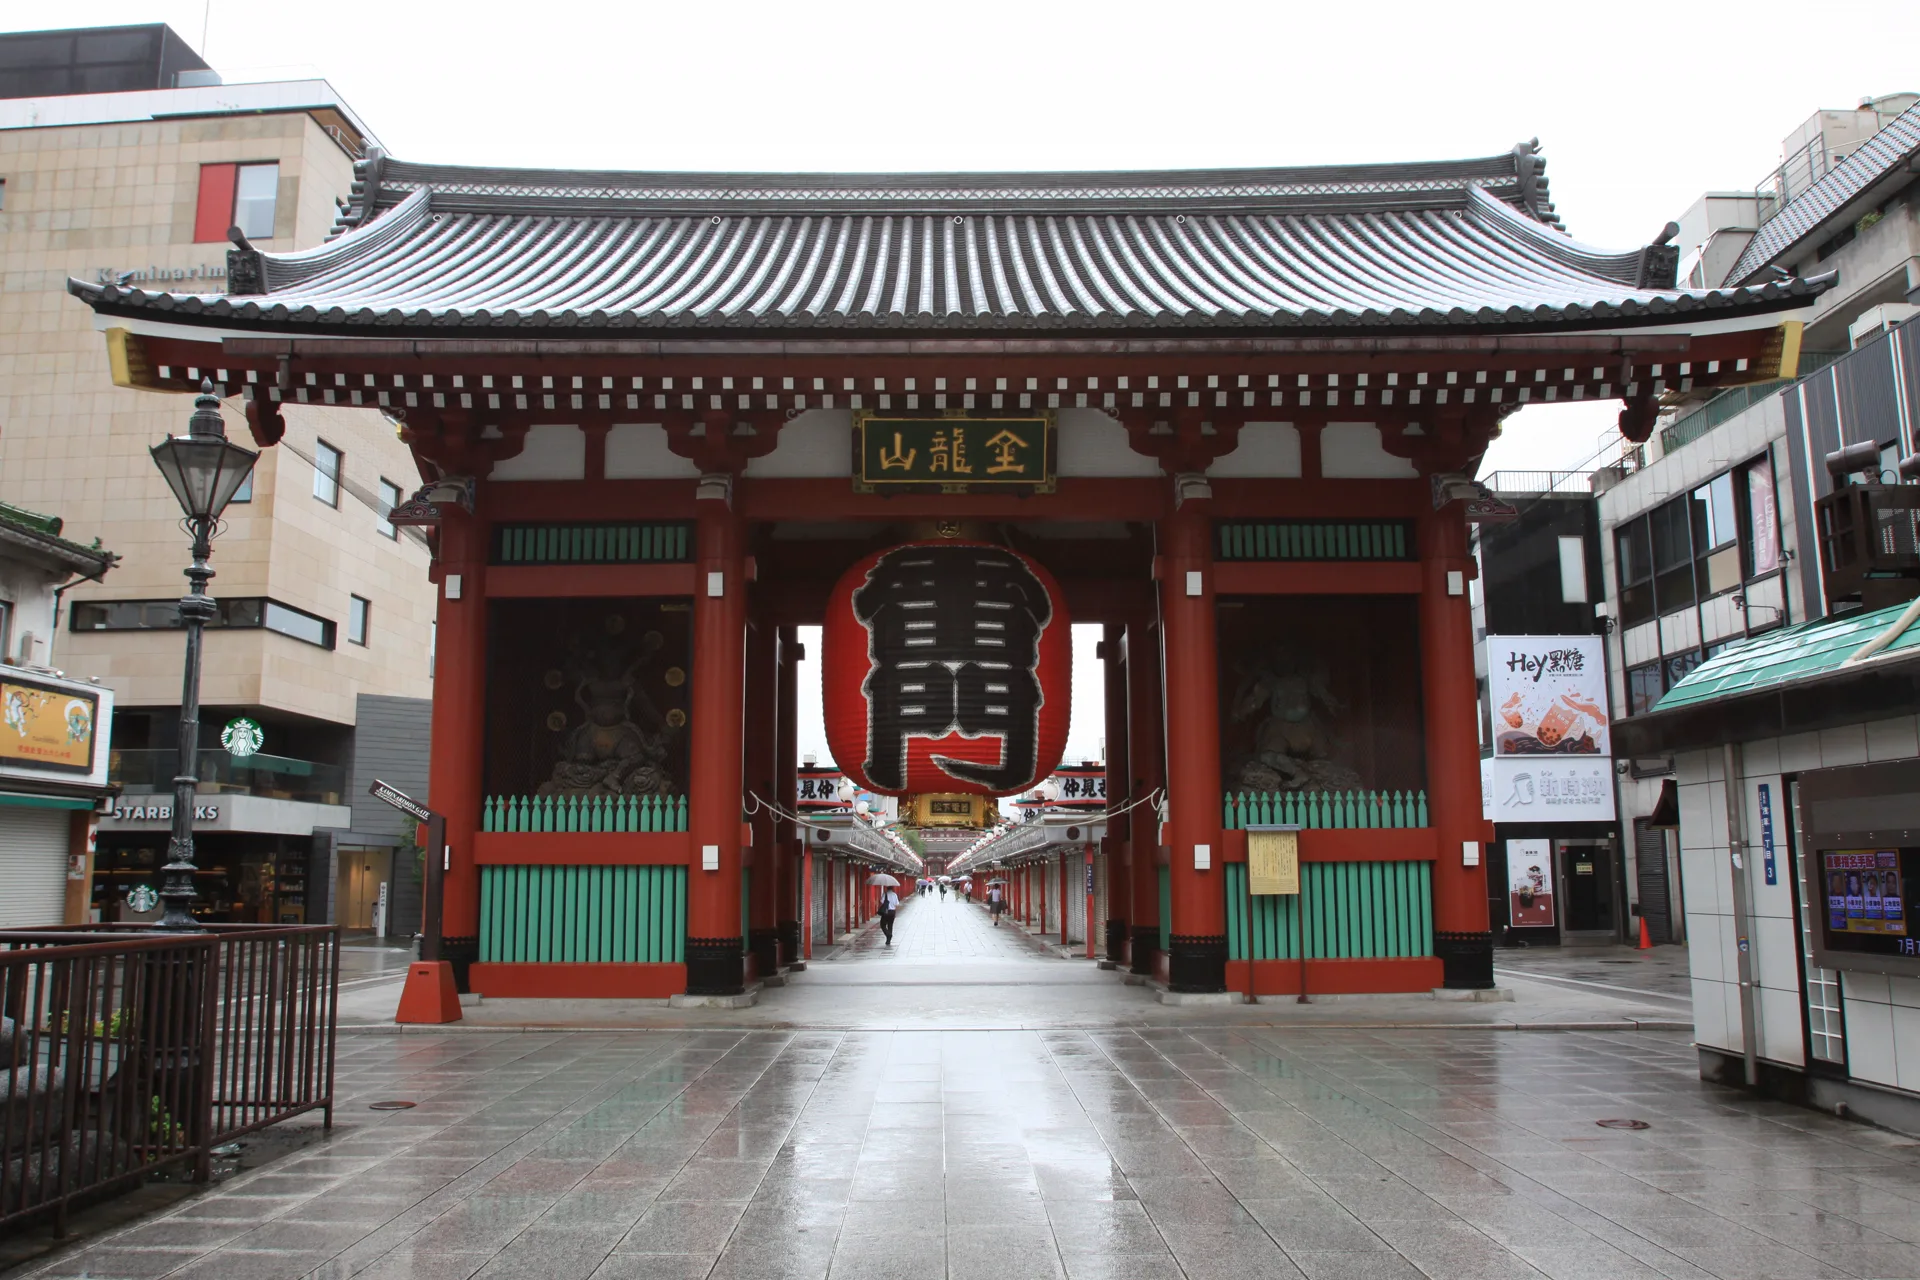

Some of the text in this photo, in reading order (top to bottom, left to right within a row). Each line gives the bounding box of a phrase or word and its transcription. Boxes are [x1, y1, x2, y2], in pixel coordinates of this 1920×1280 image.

[851, 545, 1053, 791] 雷門
[113, 806, 219, 819] STARBKS
[379, 786, 416, 809] KAMINARIMON
[415, 807, 430, 818] GATE
